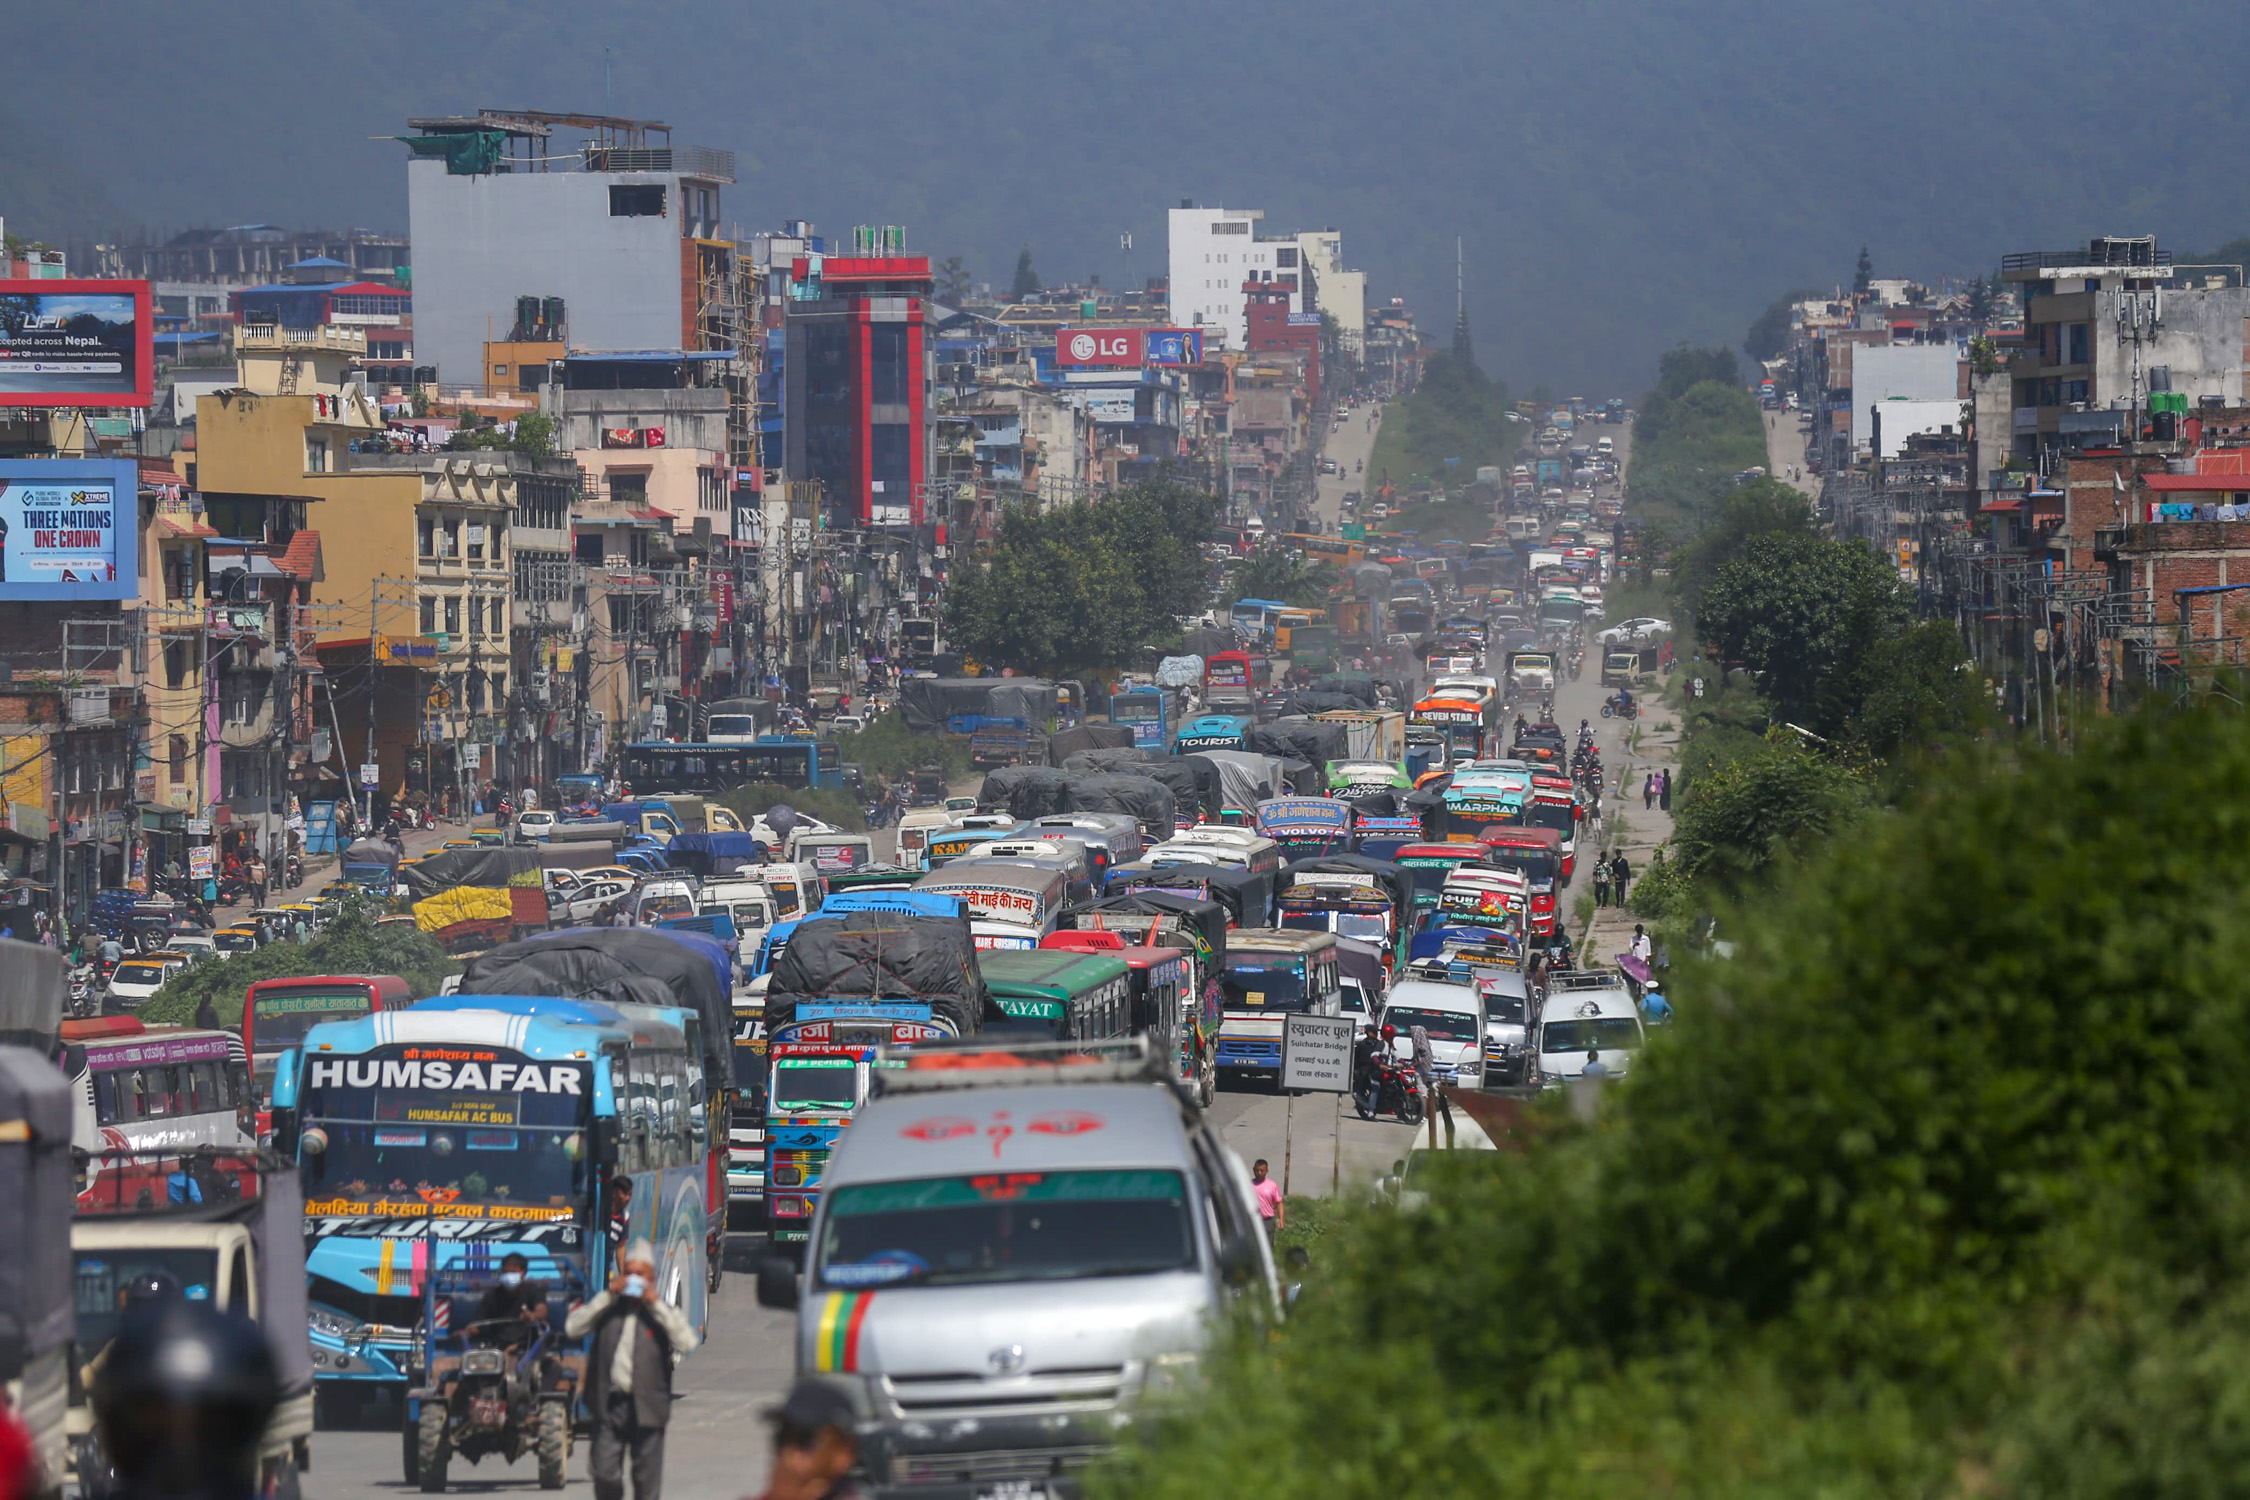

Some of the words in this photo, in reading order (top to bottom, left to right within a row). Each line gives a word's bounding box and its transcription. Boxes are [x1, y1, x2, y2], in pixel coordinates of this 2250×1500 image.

[23, 315, 61, 329] UPI
[34, 338, 62, 346] across
[65, 335, 102, 348] Nepal.
[1100, 338, 1128, 356] LG
[23, 511, 58, 528] THREE
[61, 511, 111, 528] NATIONS
[34, 530, 56, 548] ONE
[59, 530, 101, 548] CROWN
[1422, 712, 1449, 720] SEVEN
[1450, 713, 1472, 721] STAR
[1180, 737, 1240, 746] TOURIST
[1450, 803, 1507, 814] MARPHA
[981, 893, 999, 909] माई
[1000, 893, 1012, 908] की
[1013, 896, 1034, 912] जय
[997, 1000, 1053, 1017] TAYAT
[785, 1022, 830, 1042] राजा
[1334, 1026, 1351, 1040] पुल
[1291, 1040, 1323, 1049] Suichatar
[1324, 1043, 1348, 1052] Bridge
[403, 1048, 419, 1060] श्री
[422, 1048, 471, 1061] गणेशाय
[311, 1060, 582, 1095] HUMSAFAR
[408, 1109, 469, 1122] HUMSAFAR
[471, 1110, 488, 1123] AC
[490, 1111, 513, 1124] BUS
[305, 1199, 369, 1217] बेलहिया
